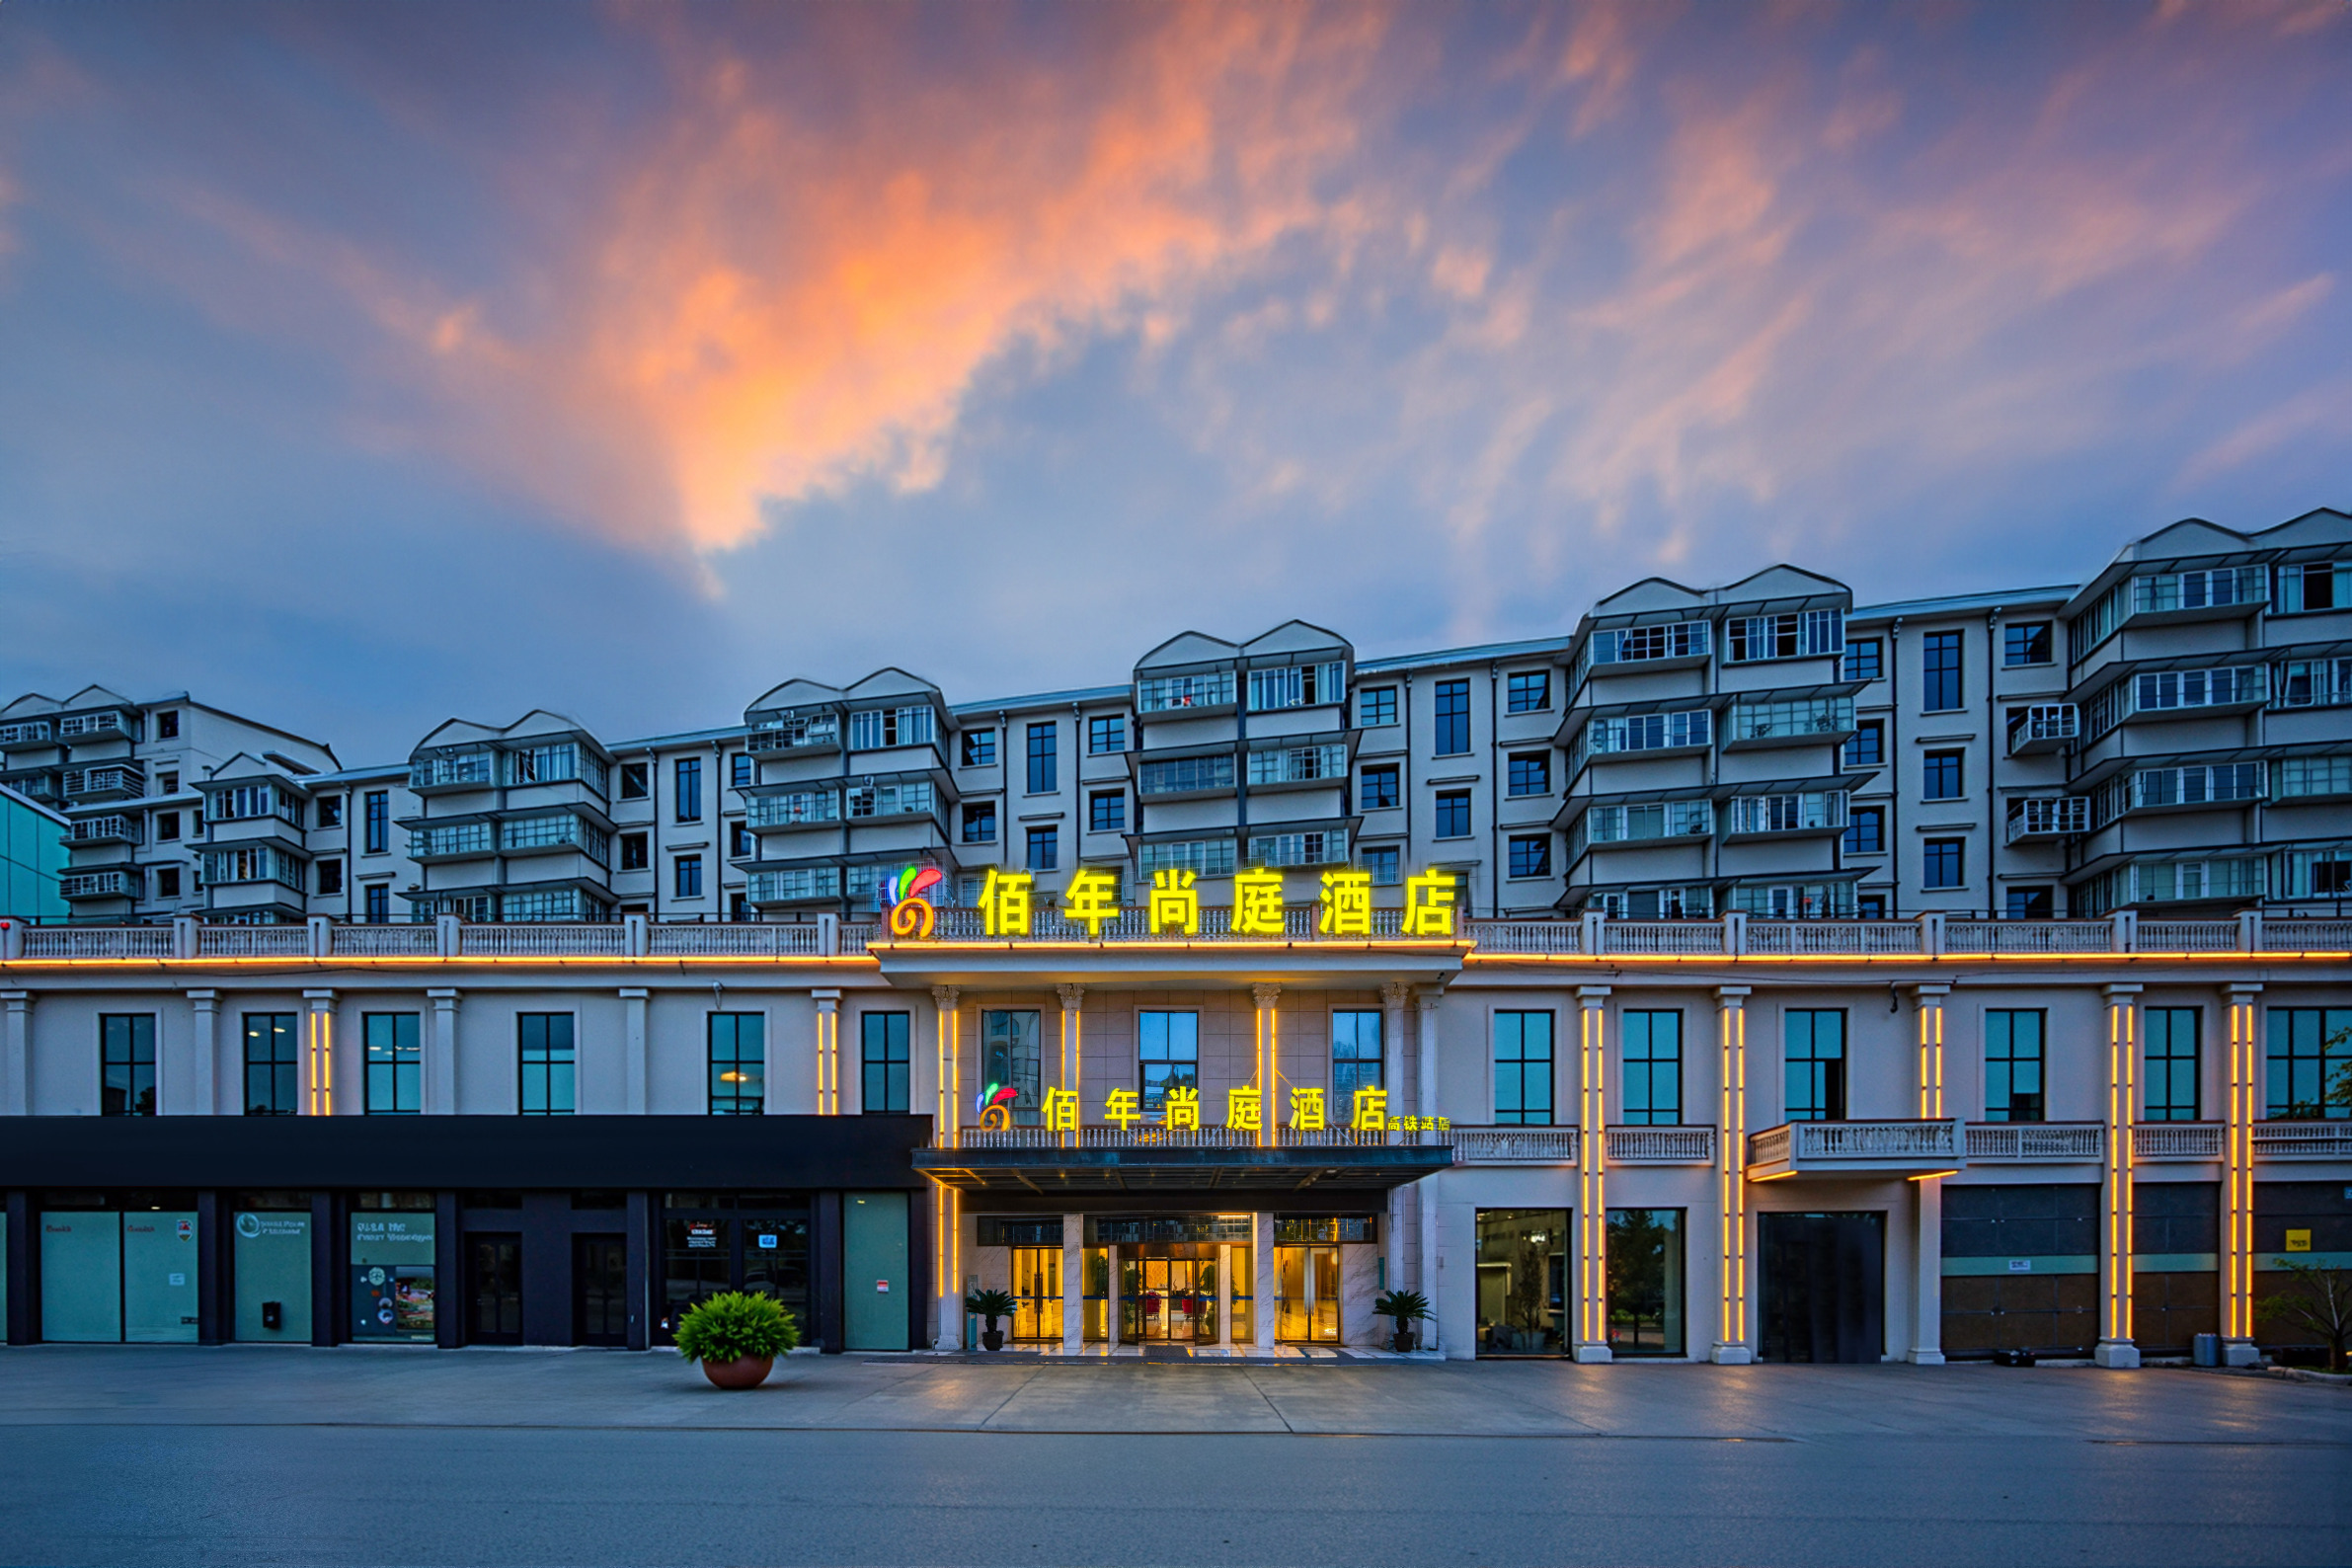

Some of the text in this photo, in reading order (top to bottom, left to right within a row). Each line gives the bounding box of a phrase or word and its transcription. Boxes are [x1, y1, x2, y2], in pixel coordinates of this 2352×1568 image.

[978, 868, 1456, 935] 佰年尚庭酒店
[1041, 1085, 1387, 1131] 佰年尚庭酒店
